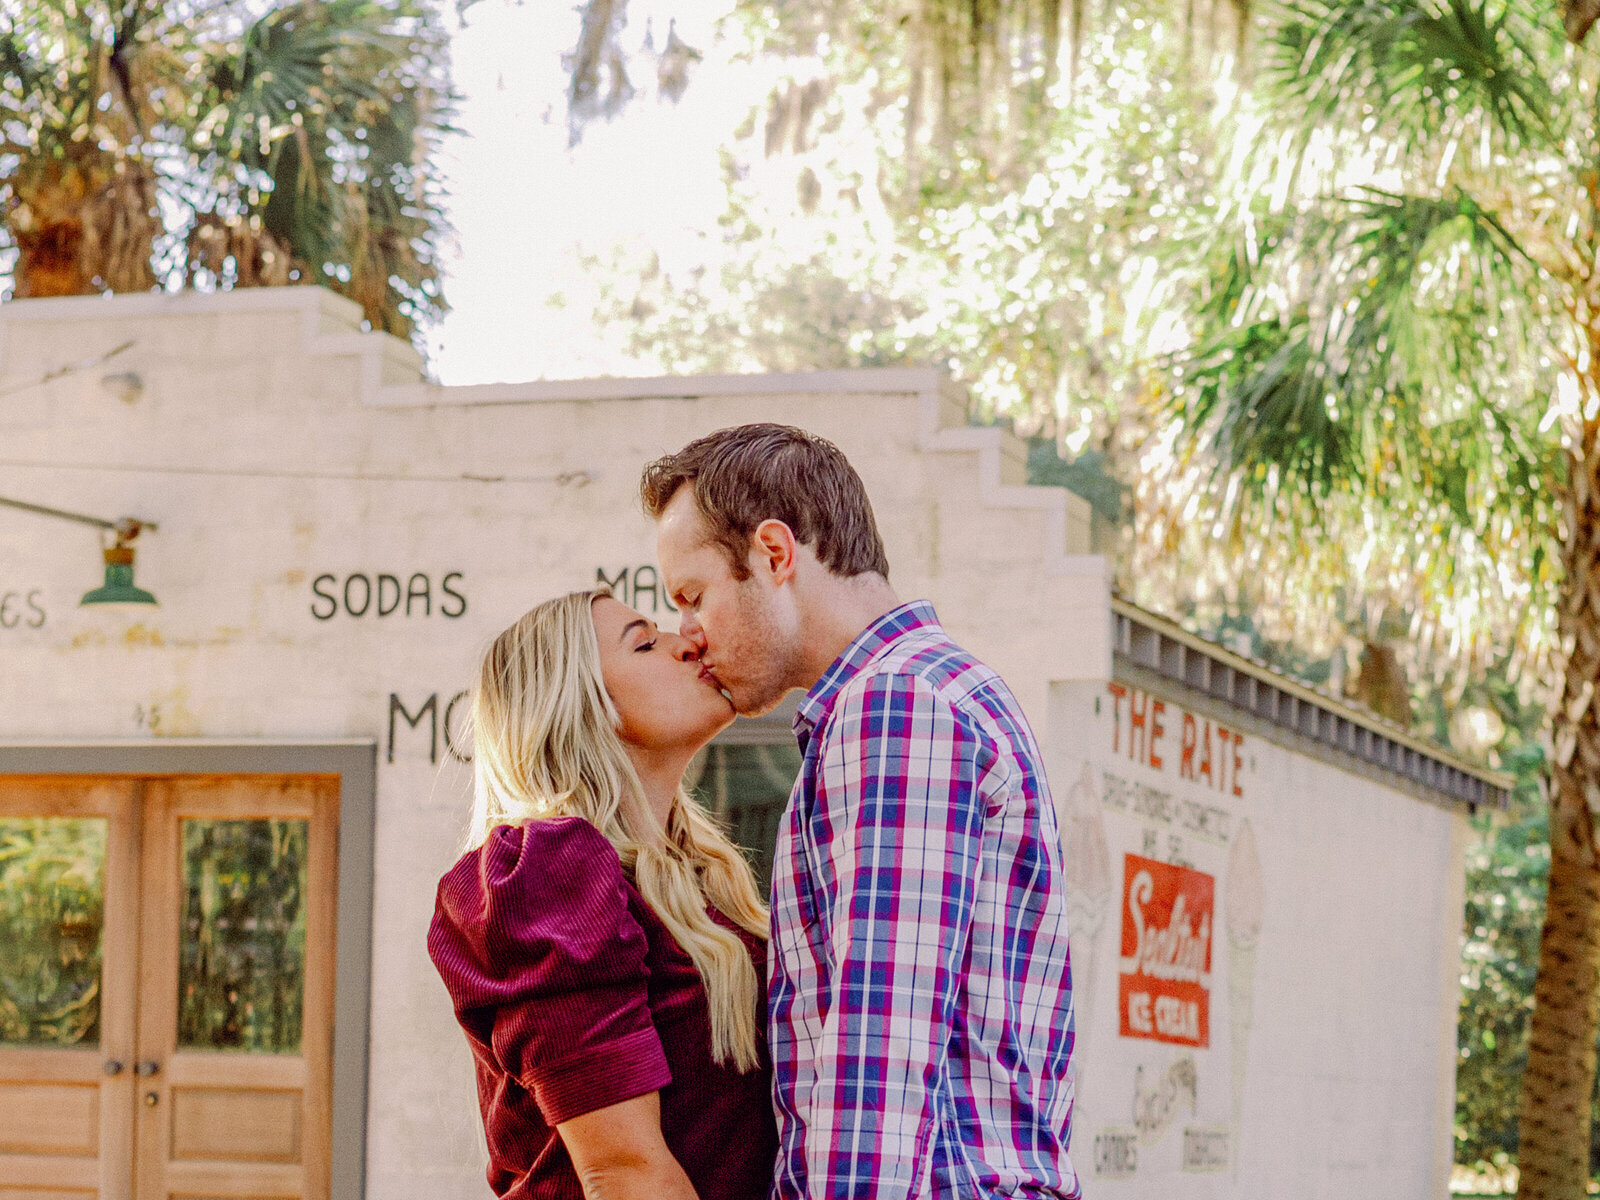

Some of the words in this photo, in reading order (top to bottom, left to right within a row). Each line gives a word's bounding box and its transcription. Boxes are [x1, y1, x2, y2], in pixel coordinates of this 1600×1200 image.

[311, 572, 467, 620] SODAS
[1108, 681, 1165, 771] THE
[1181, 713, 1244, 797] RATE
